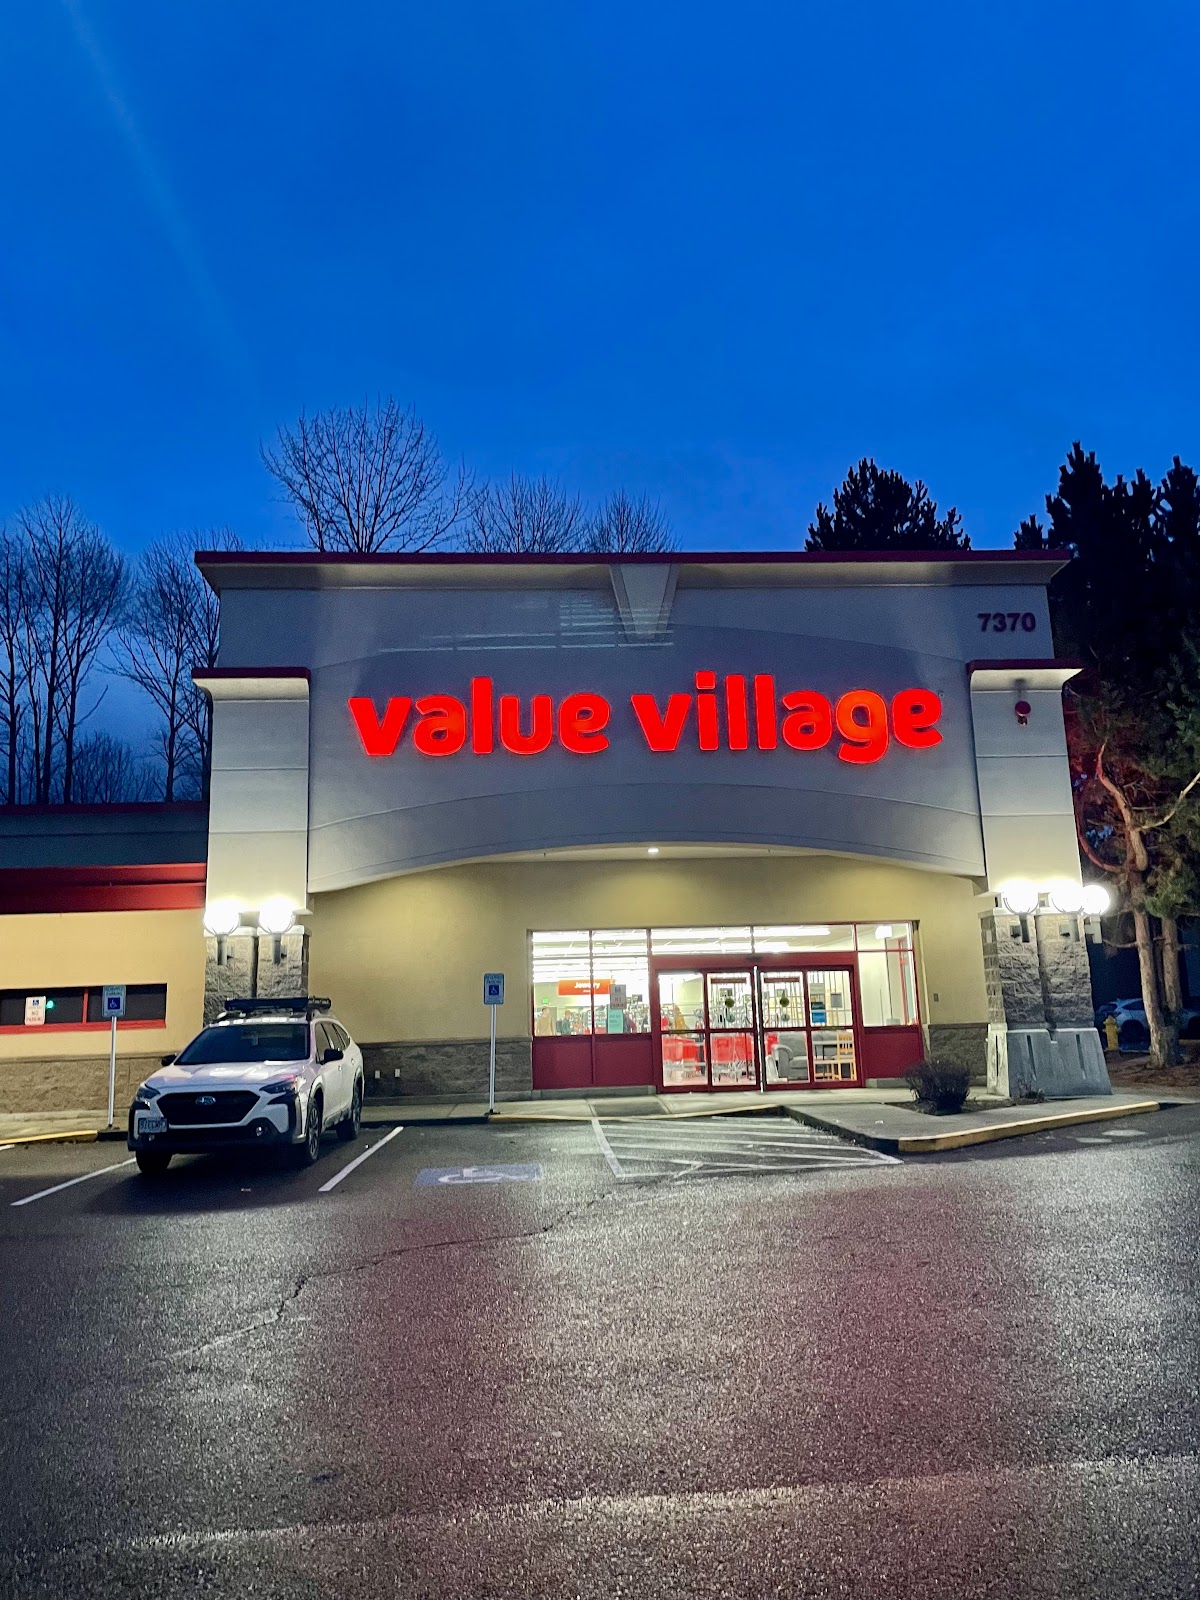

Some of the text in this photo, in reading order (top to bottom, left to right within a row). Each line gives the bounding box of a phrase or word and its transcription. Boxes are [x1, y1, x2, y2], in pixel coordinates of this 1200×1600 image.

[977, 612, 1036, 632] 7370
[348, 671, 942, 764] value village
